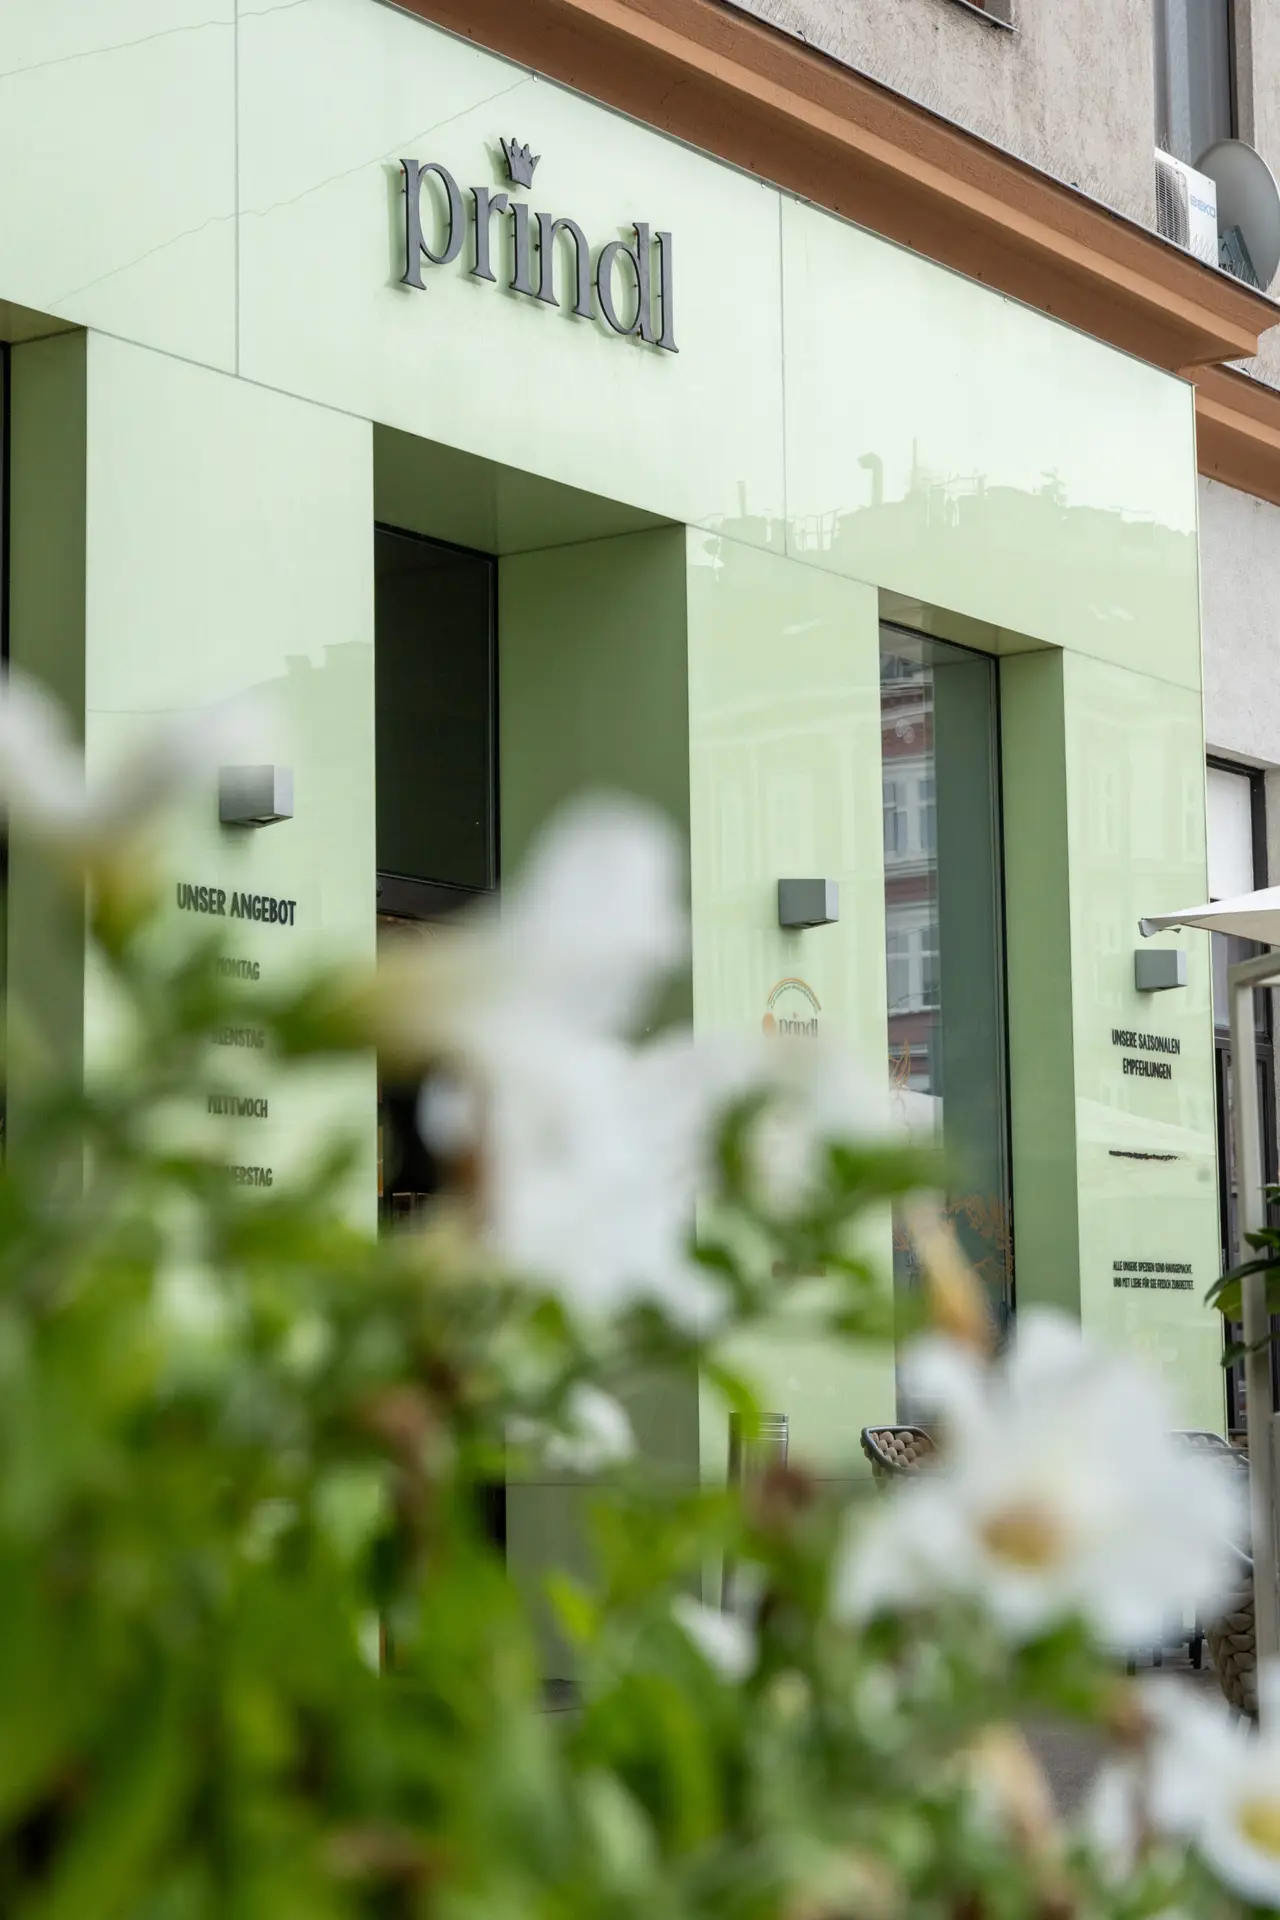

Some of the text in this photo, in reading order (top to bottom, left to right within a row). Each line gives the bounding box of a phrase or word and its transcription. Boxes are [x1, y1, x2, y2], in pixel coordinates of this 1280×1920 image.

[400, 157, 679, 353] prindl
[176, 882, 297, 926] UNSER ANGEBOT
[215, 956, 260, 981] MONTAG
[1111, 1028, 1180, 1054] UNSERE SAISONALEN
[208, 1095, 268, 1119] MITTWOCH
